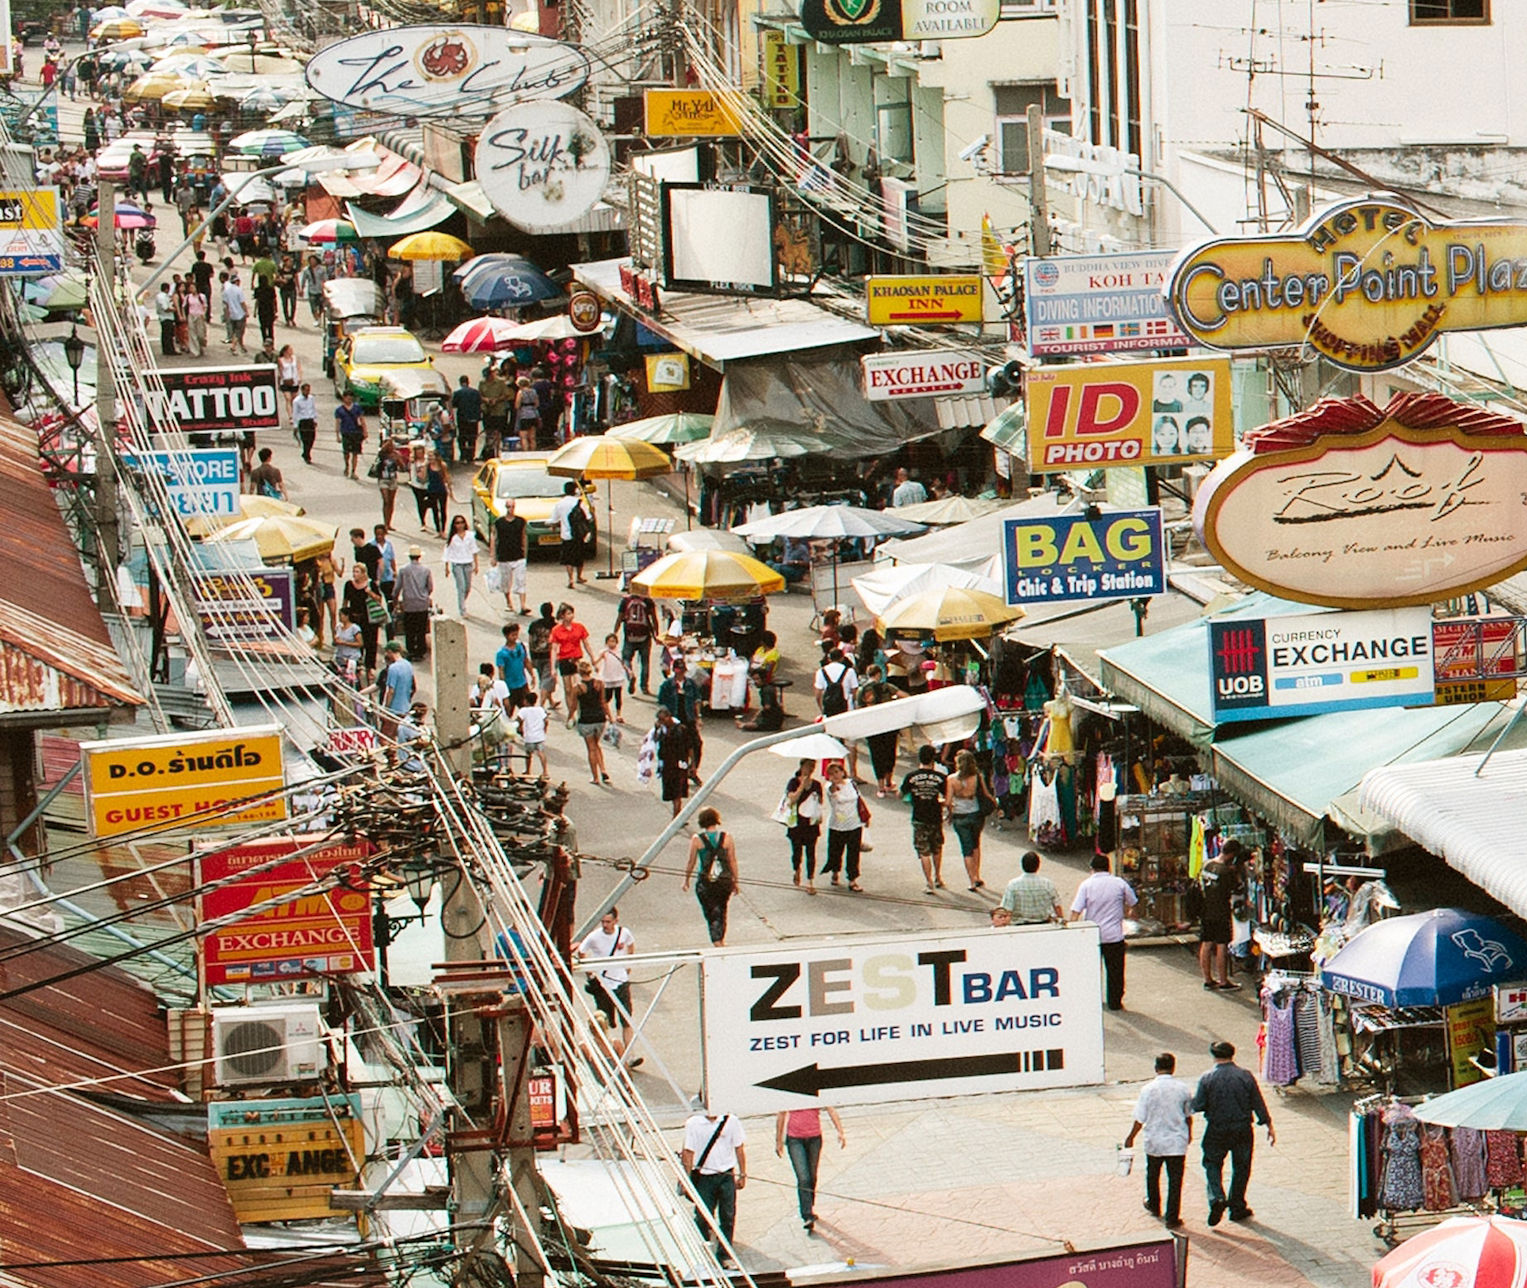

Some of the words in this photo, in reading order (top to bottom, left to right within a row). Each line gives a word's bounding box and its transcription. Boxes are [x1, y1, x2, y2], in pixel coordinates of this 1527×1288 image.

[926, 0, 972, 13] ROOM
[913, 17, 988, 34] AVAILABLE
[339, 46, 424, 101] The
[459, 60, 571, 93] Club
[489, 128, 566, 170] Silk
[519, 163, 550, 190] bar
[1311, 208, 1428, 253] HOTEL
[1063, 262, 1112, 274] BUDDHA
[1113, 260, 1142, 271] VIEW
[1089, 271, 1133, 289] KOH
[873, 286, 931, 297] KHAOSAN
[934, 285, 978, 296] PALACE
[1179, 261, 1329, 331] Center
[1332, 246, 1439, 304] Point
[908, 298, 945, 309] INN
[1037, 298, 1079, 321] DIVING
[1083, 293, 1165, 318] INFORMATION
[1040, 341, 1107, 353] TOURIST
[184, 373, 225, 385] Crazy
[229, 372, 252, 384] Ink
[871, 362, 982, 388] EXCHANGE
[149, 385, 277, 422] TATTOO
[1045, 381, 1142, 440] ID
[1046, 440, 1140, 464] PHOTO
[1015, 517, 1152, 569] BAG
[1265, 547, 1334, 564] Balcony
[1343, 541, 1378, 555] View
[1383, 538, 1419, 552] and
[1420, 535, 1458, 550] Live
[1463, 532, 1517, 546] Music
[1018, 561, 1152, 578] LOCKER
[1017, 576, 1048, 598] Chic
[1051, 576, 1064, 596] &
[1067, 572, 1097, 597] Trip
[1101, 570, 1153, 592] Station
[1272, 628, 1341, 644] CURRENCY
[1273, 636, 1428, 668] EXCHANGE
[1219, 675, 1264, 696] UOB
[1295, 675, 1323, 689] atm
[1444, 690, 1487, 702] UNION
[105, 804, 185, 825] GUEST
[218, 926, 362, 952] EXCHANGE
[750, 949, 967, 1023] ZEST
[963, 966, 1060, 1006] BAR
[750, 1034, 801, 1052] ZEST
[810, 1030, 851, 1047] FOR
[860, 1025, 900, 1042] LIFE
[911, 1022, 933, 1038] IN
[942, 1018, 985, 1035] LIVE
[994, 1013, 1063, 1032] MUSIC
